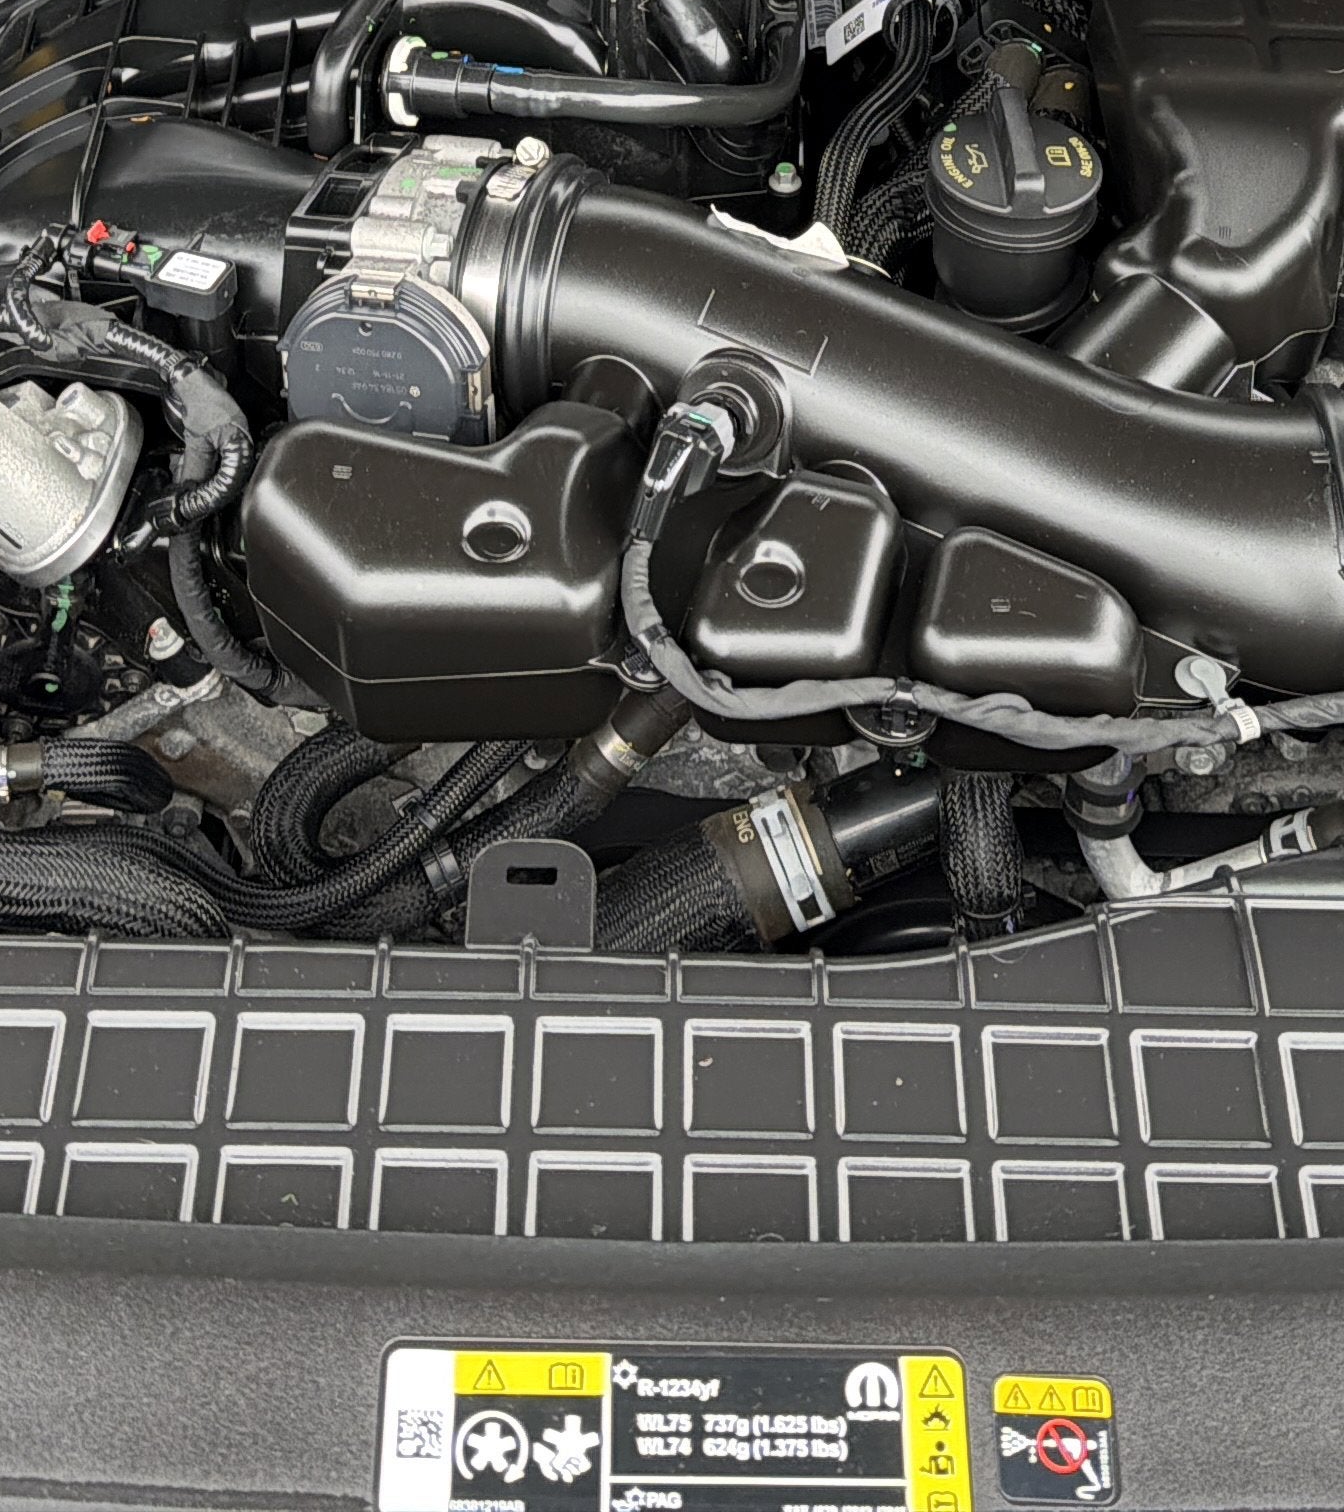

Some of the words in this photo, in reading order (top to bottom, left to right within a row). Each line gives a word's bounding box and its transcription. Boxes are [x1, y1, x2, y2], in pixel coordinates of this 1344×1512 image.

[940, 136, 957, 153] OIL
[940, 154, 975, 189] ENGINE
[732, 810, 755, 844] ENG
[635, 1413, 693, 1433] WL75
[702, 1414, 750, 1437] 737g
[752, 1415, 808, 1437] (1.625
[810, 1415, 848, 1438] lbs)
[635, 1437, 693, 1456] WL74
[702, 1438, 751, 1461] 624g
[752, 1439, 808, 1461] (1.375
[810, 1440, 849, 1462] lbs)
[646, 1491, 683, 1509] PAG
